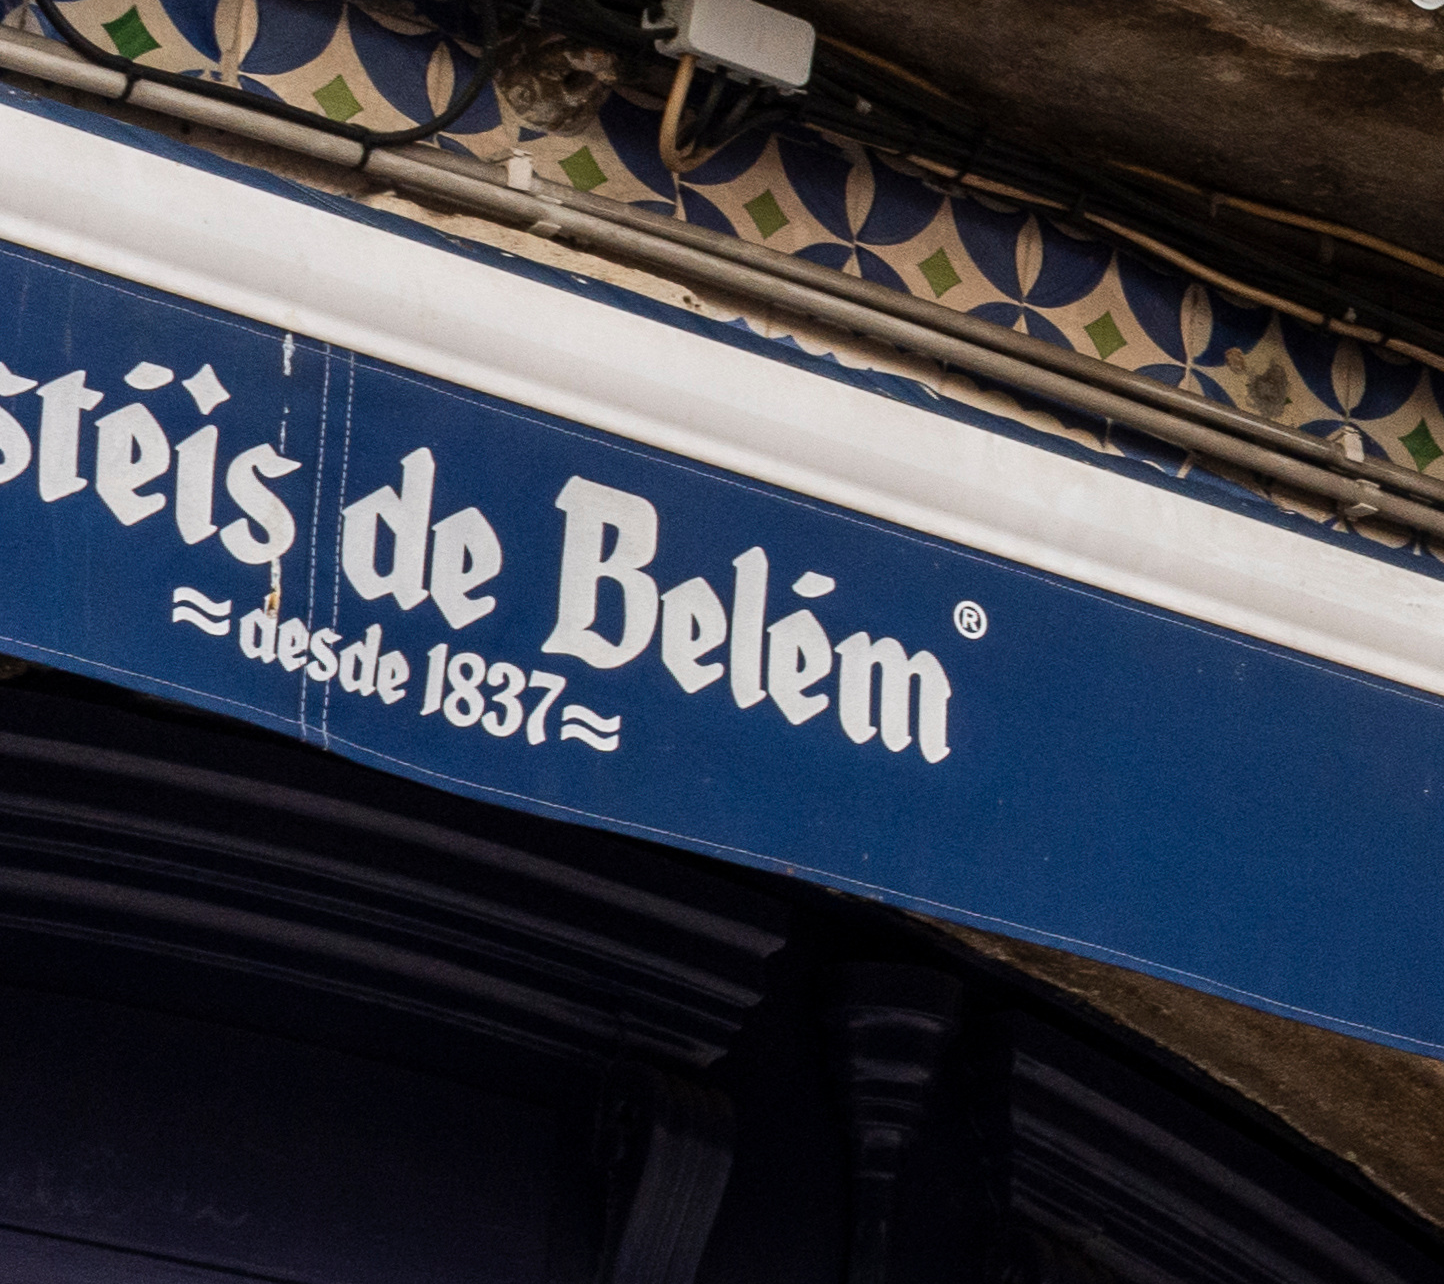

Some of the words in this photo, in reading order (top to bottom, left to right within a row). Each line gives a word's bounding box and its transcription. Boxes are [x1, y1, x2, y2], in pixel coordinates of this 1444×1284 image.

[342, 447, 503, 629] de
[239, 603, 409, 706] desde
[421, 644, 567, 746] 1837
